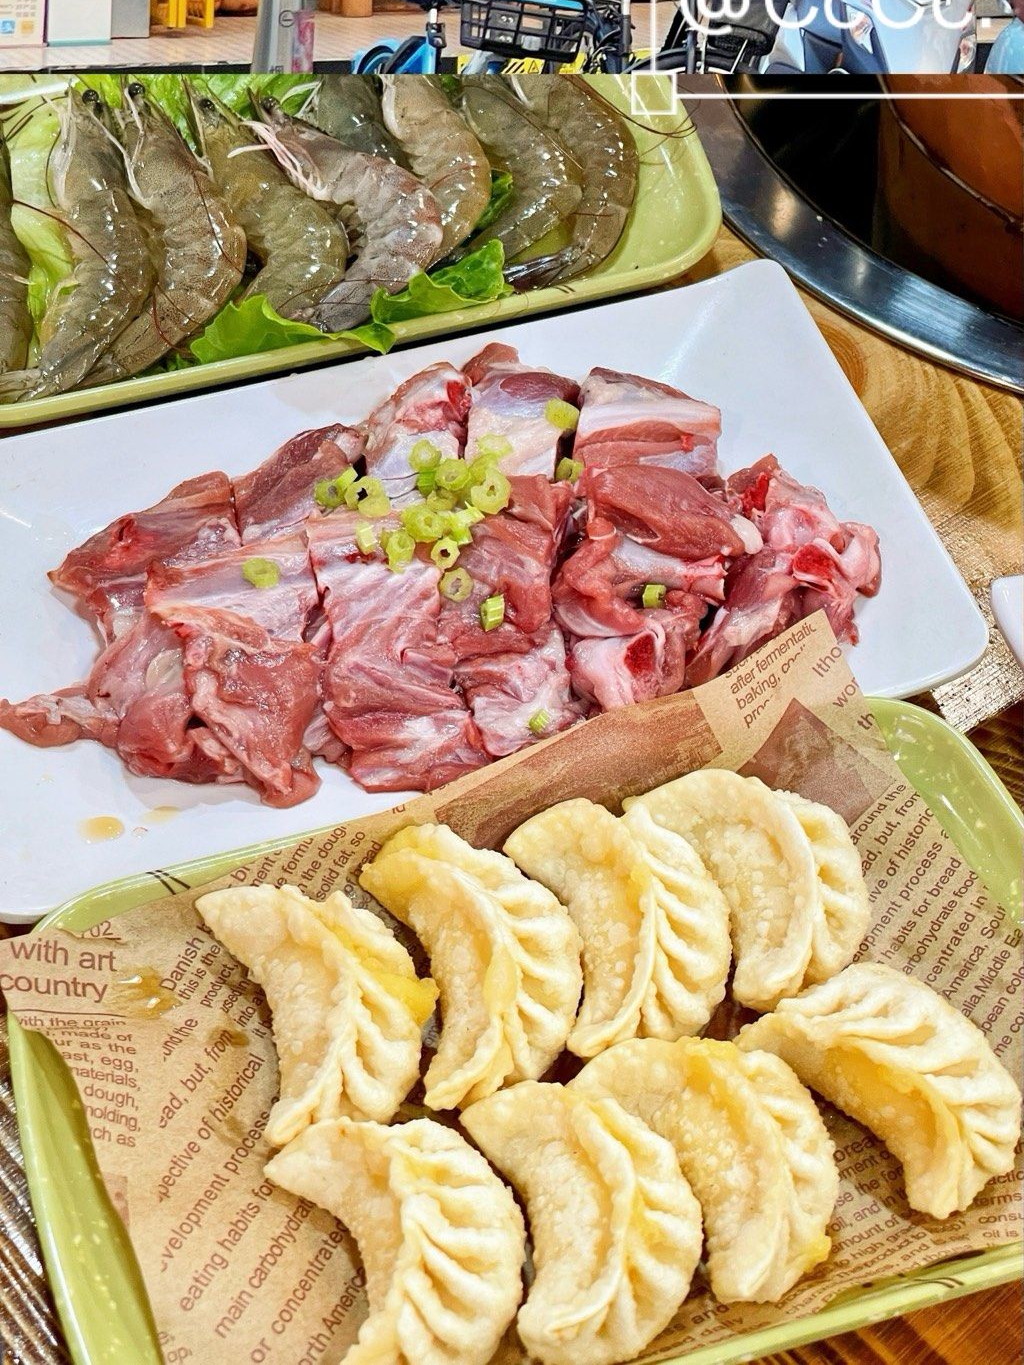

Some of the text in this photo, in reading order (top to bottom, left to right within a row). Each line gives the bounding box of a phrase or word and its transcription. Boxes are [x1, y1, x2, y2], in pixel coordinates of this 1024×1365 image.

[10, 939, 117, 972] with art
[160, 936, 205, 992] Danish
[0, 973, 108, 1003] country
[209, 1053, 266, 1123] historical
[179, 1252, 228, 1313] eating
[217, 1200, 262, 1253] habits
[215, 1287, 254, 1339] main
